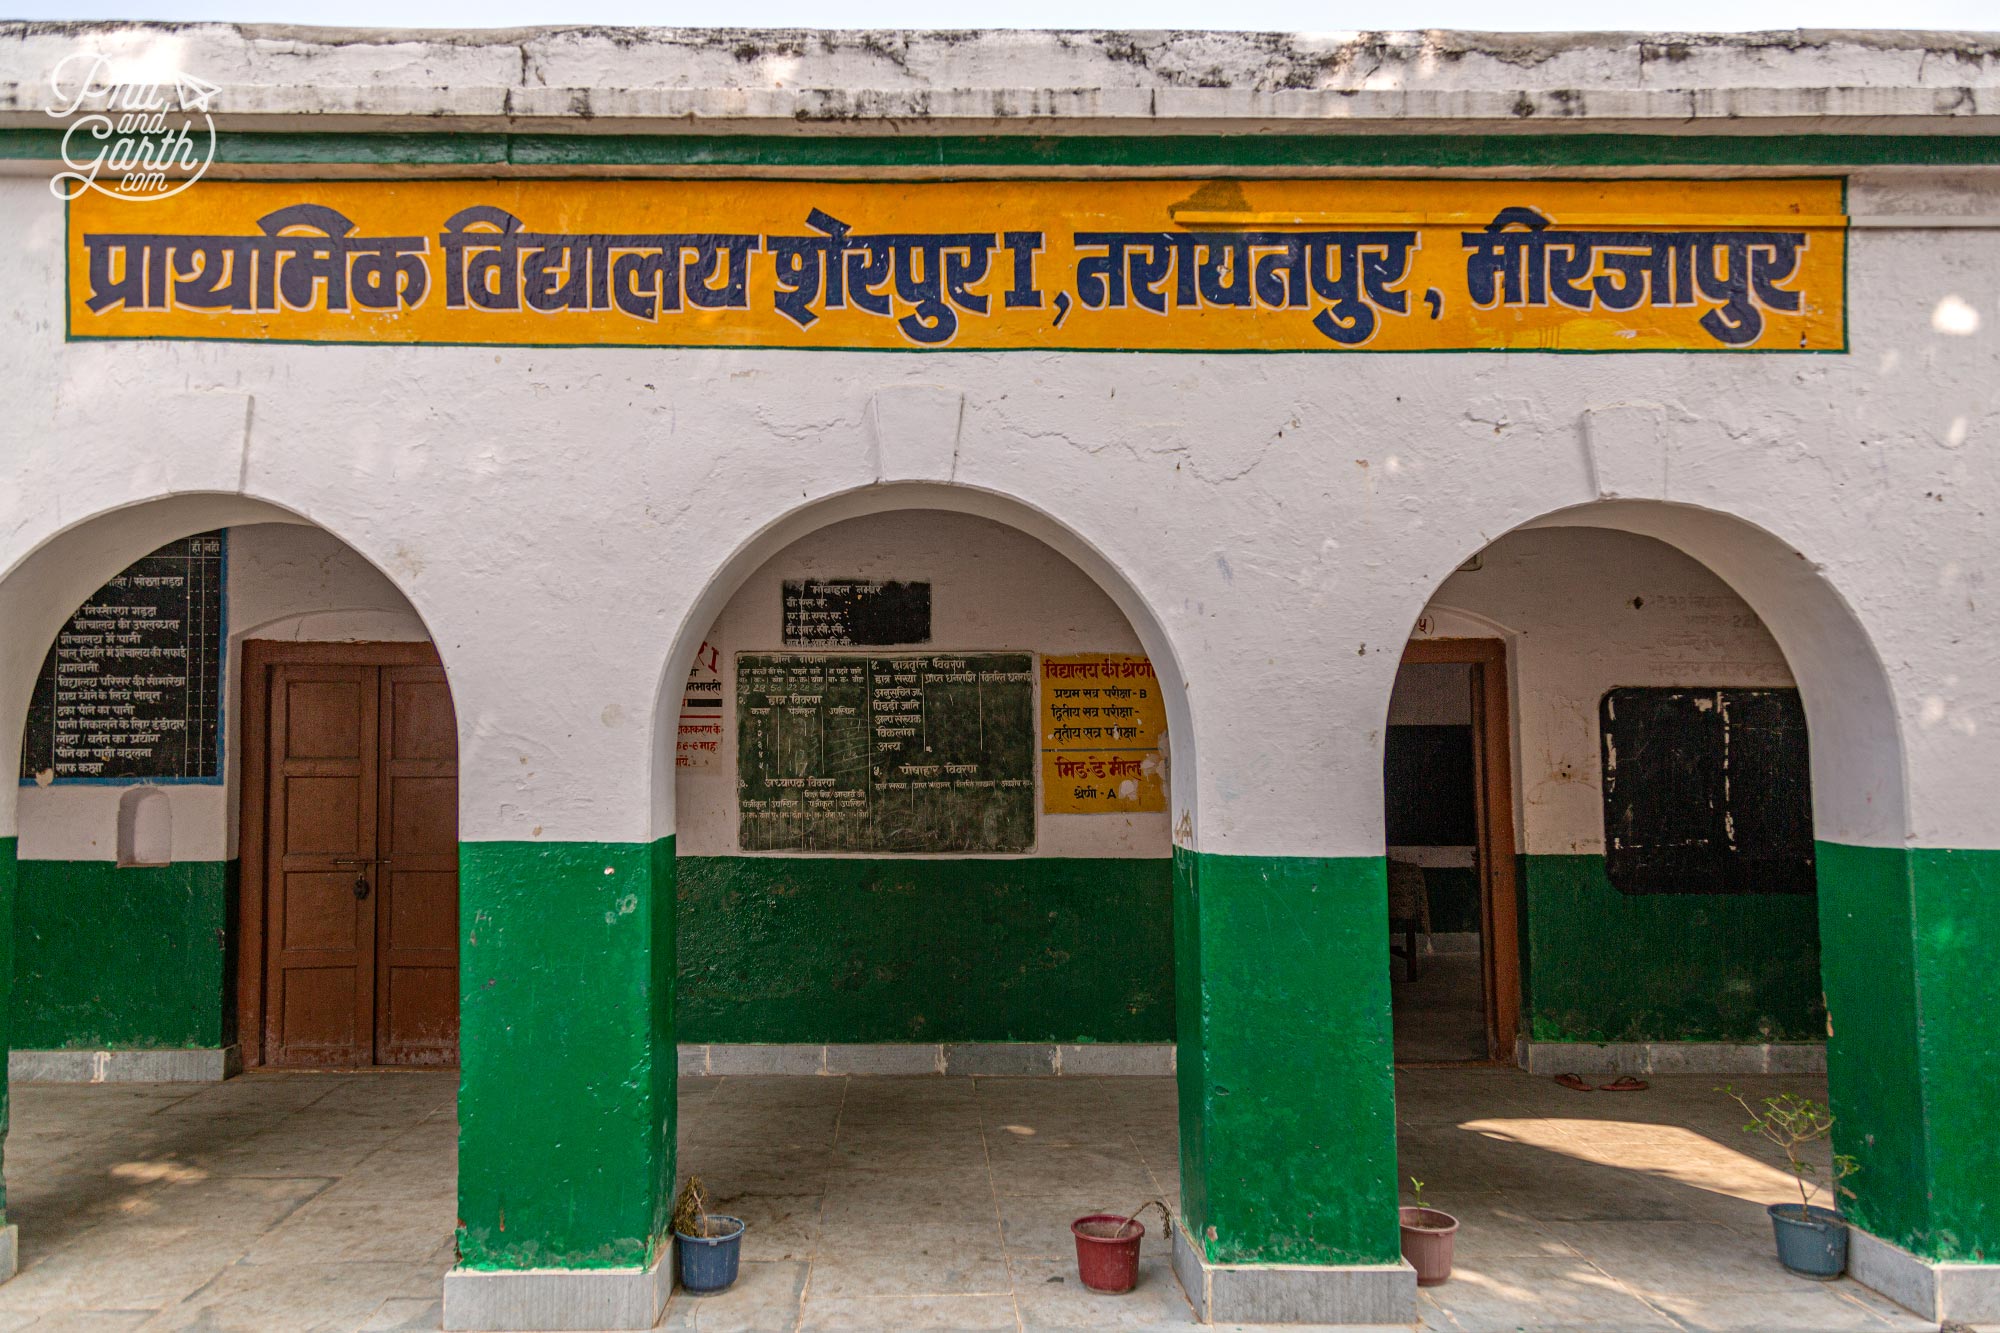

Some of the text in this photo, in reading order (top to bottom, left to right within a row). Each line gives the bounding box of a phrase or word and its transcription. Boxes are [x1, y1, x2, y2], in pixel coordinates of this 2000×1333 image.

[84, 204, 430, 315] प्राथमिक
[440, 205, 762, 322] विद्यालय
[767, 207, 1000, 346] शेरपुर
[1462, 206, 1808, 346] मीरजापुर
[118, 617, 131, 630] की
[118, 632, 142, 644] पानी
[932, 657, 966, 669] विवरण
[1043, 658, 1101, 680] विद्यालय
[1101, 658, 1120, 680] की
[58, 676, 97, 688] विद्यालय
[99, 675, 131, 688] परिसर
[132, 675, 145, 687] की
[788, 693, 822, 705] विवरण
[1053, 685, 1147, 701] प्रथम सत्र परीक्षा B
[97, 705, 110, 716] का
[112, 703, 136, 716] पानी
[1050, 703, 1134, 722] द्वितीय सत्र परीक्षा
[57, 718, 77, 730] पानी
[119, 717, 129, 730] के
[112, 734, 126, 744] का
[1052, 724, 1081, 745] तृतीय
[1083, 727, 1102, 741] सत्र
[75, 748, 91, 758] का
[117, 748, 153, 761] बदलना
[56, 762, 77, 775] साफ
[1073, 785, 1117, 800] श्रेणी A
